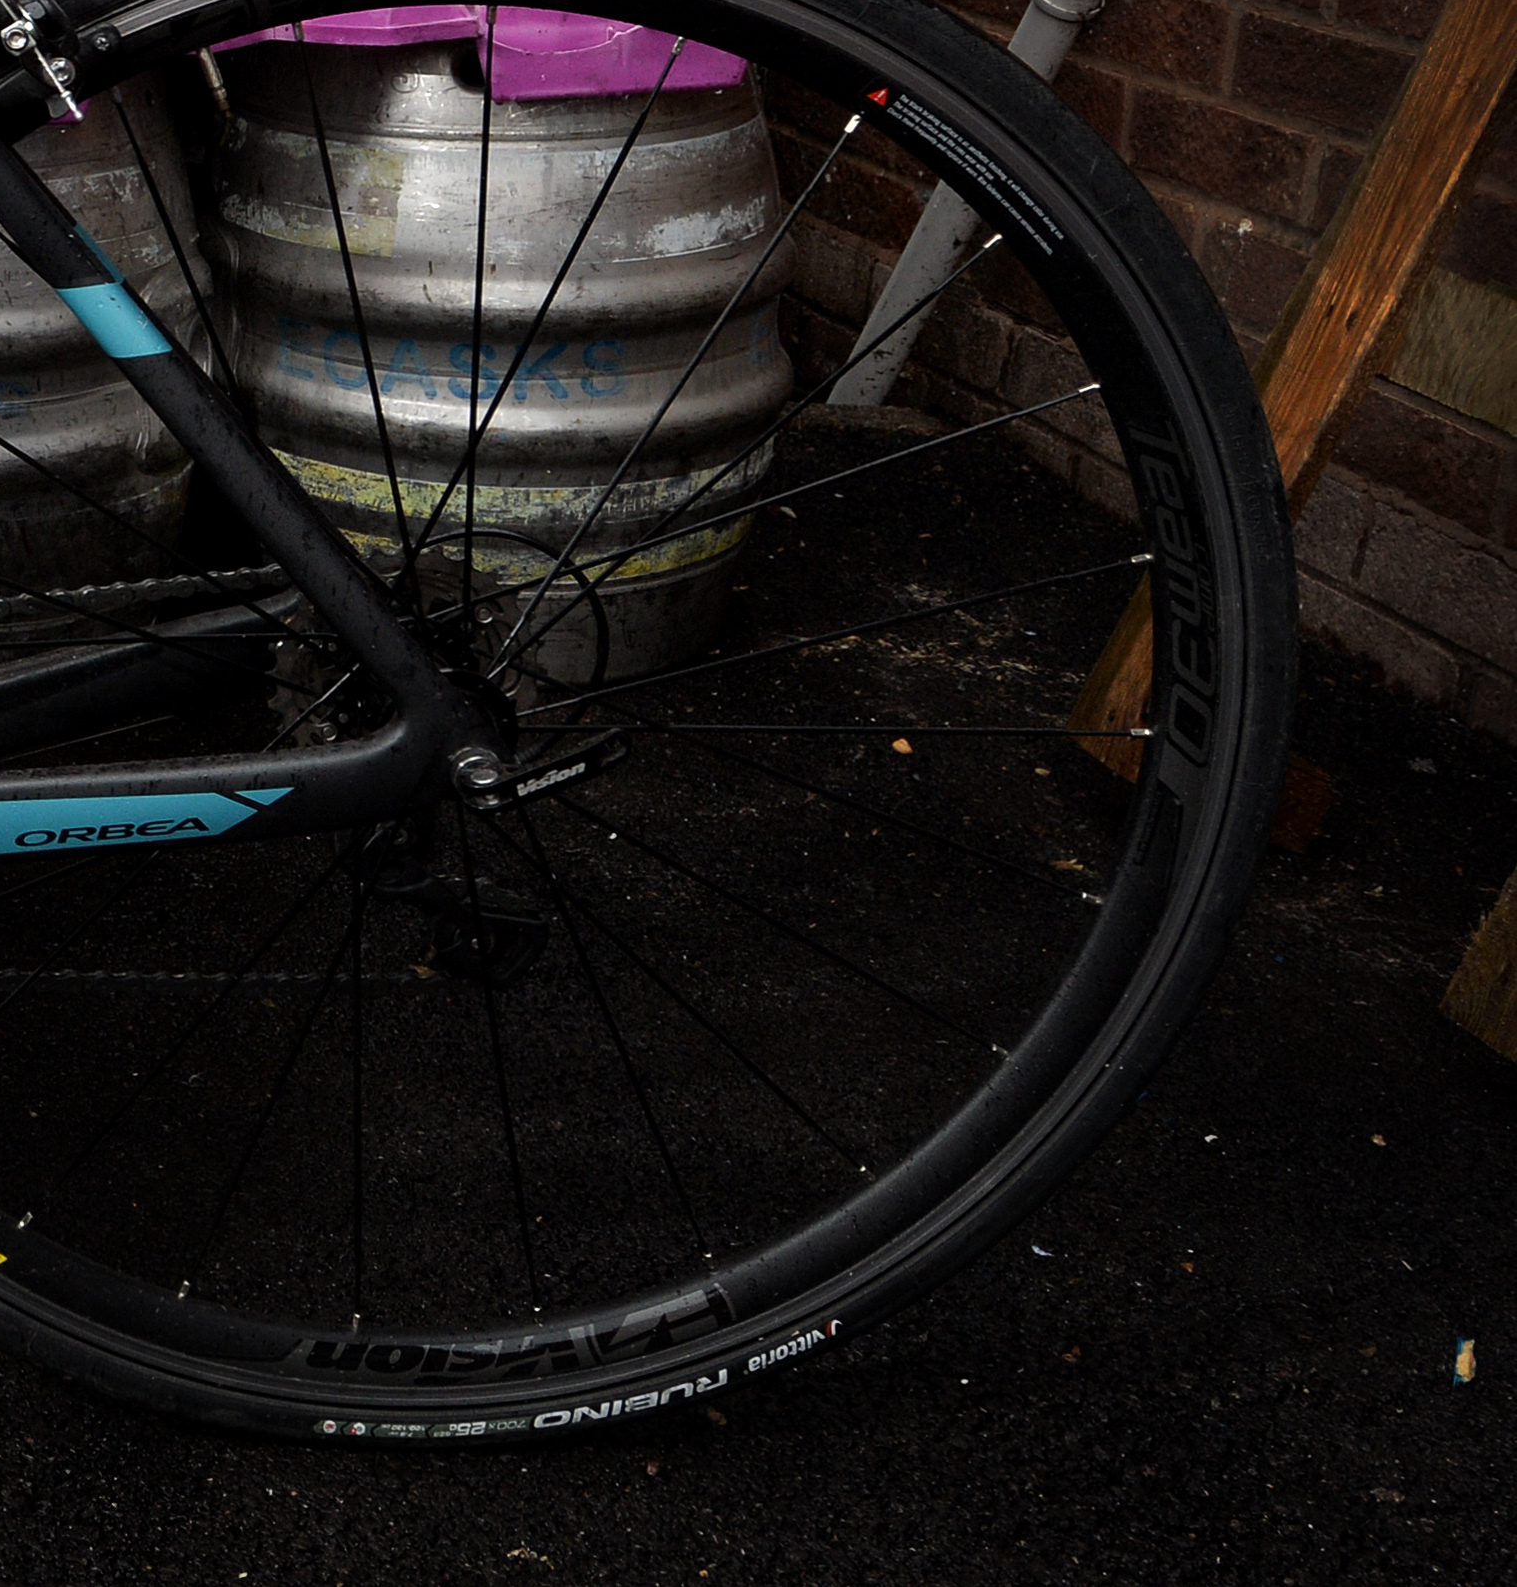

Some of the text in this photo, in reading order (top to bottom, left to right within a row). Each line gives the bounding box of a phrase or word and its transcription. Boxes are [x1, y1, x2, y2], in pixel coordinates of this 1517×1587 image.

[273, 318, 628, 402] ECASKS
[516, 761, 585, 796] Vision
[14, 817, 210, 848] ORBEA
[747, 1327, 826, 1375] vittoria
[533, 1367, 729, 1430] RUBINO
